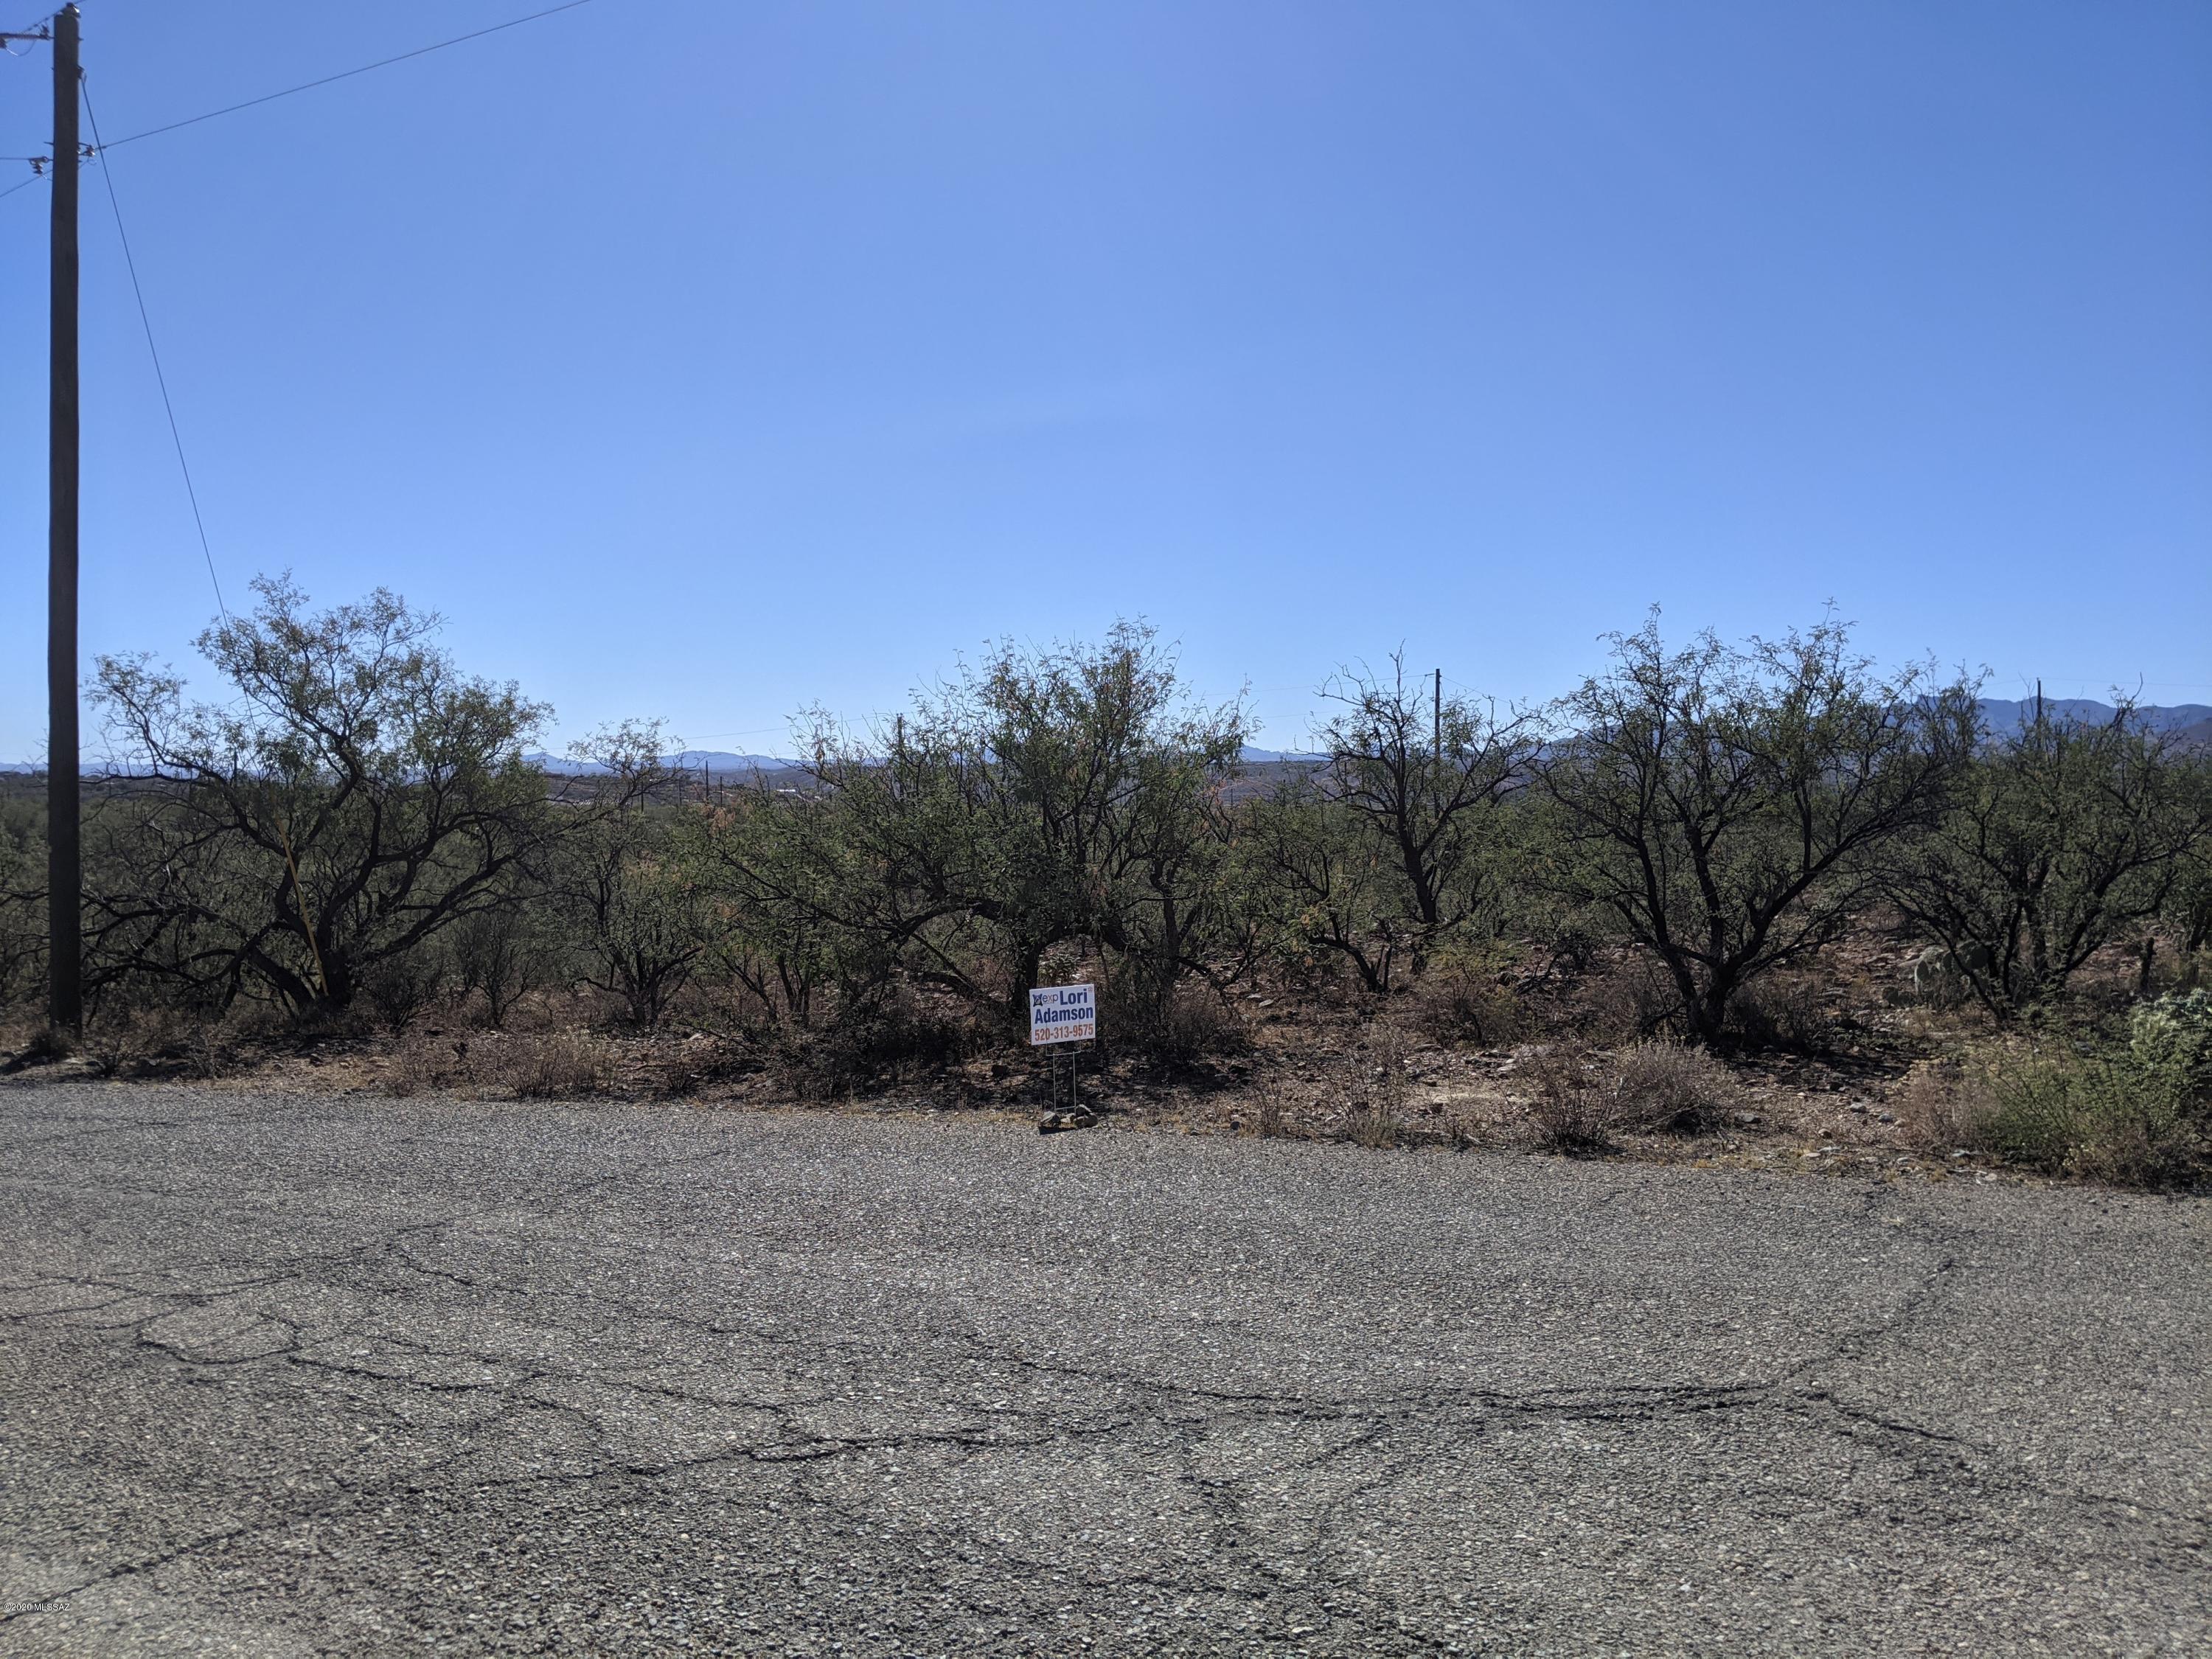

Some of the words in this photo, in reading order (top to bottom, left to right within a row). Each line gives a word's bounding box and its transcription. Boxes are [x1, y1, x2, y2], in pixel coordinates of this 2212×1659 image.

[1060, 989, 1088, 1005] Lori
[1034, 1007, 1093, 1024] Adamson
[1034, 1023, 1093, 1041] 520-313-9575
